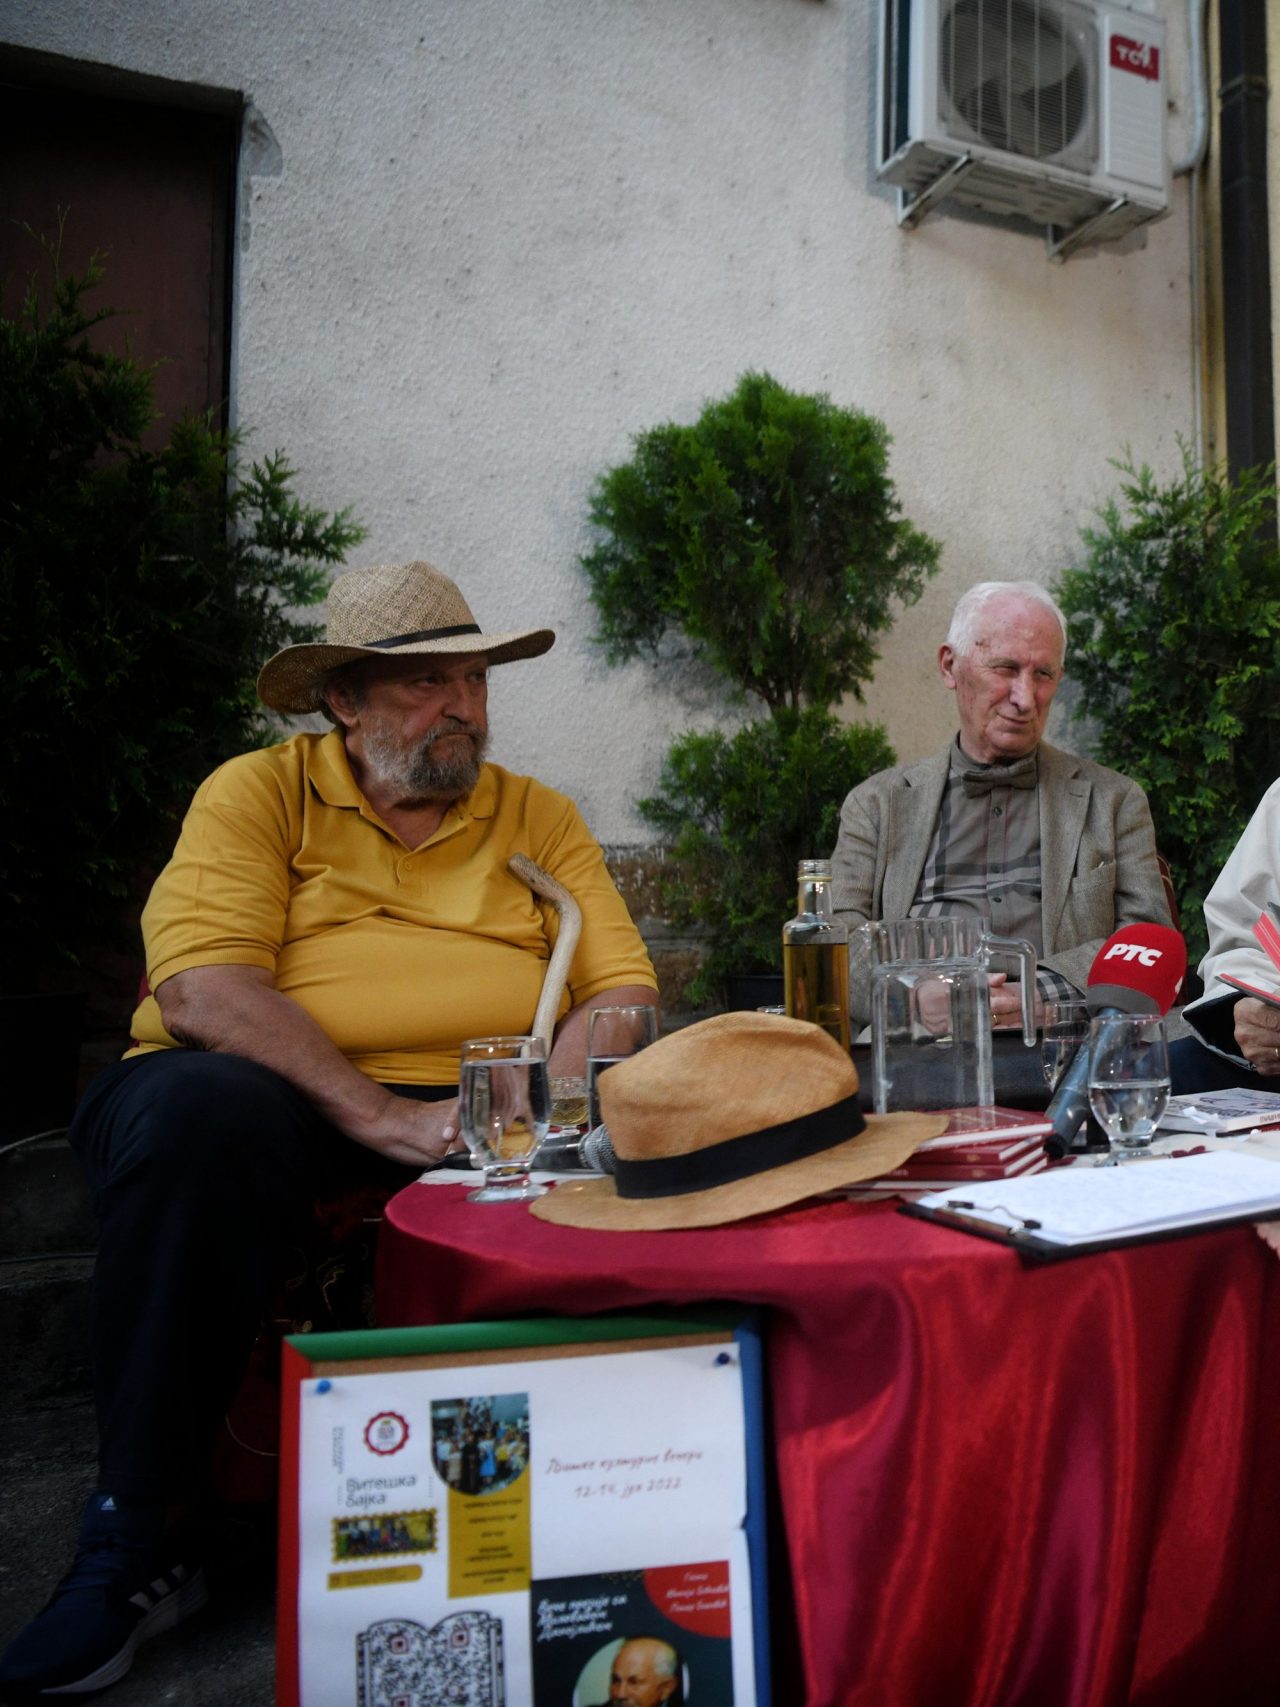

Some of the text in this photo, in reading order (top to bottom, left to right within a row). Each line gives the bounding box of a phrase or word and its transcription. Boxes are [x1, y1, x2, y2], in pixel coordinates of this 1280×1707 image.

[1103, 943, 1163, 967] РТС
[346, 1476, 416, 1493] Витешка
[647, 1477, 682, 1492] 2022
